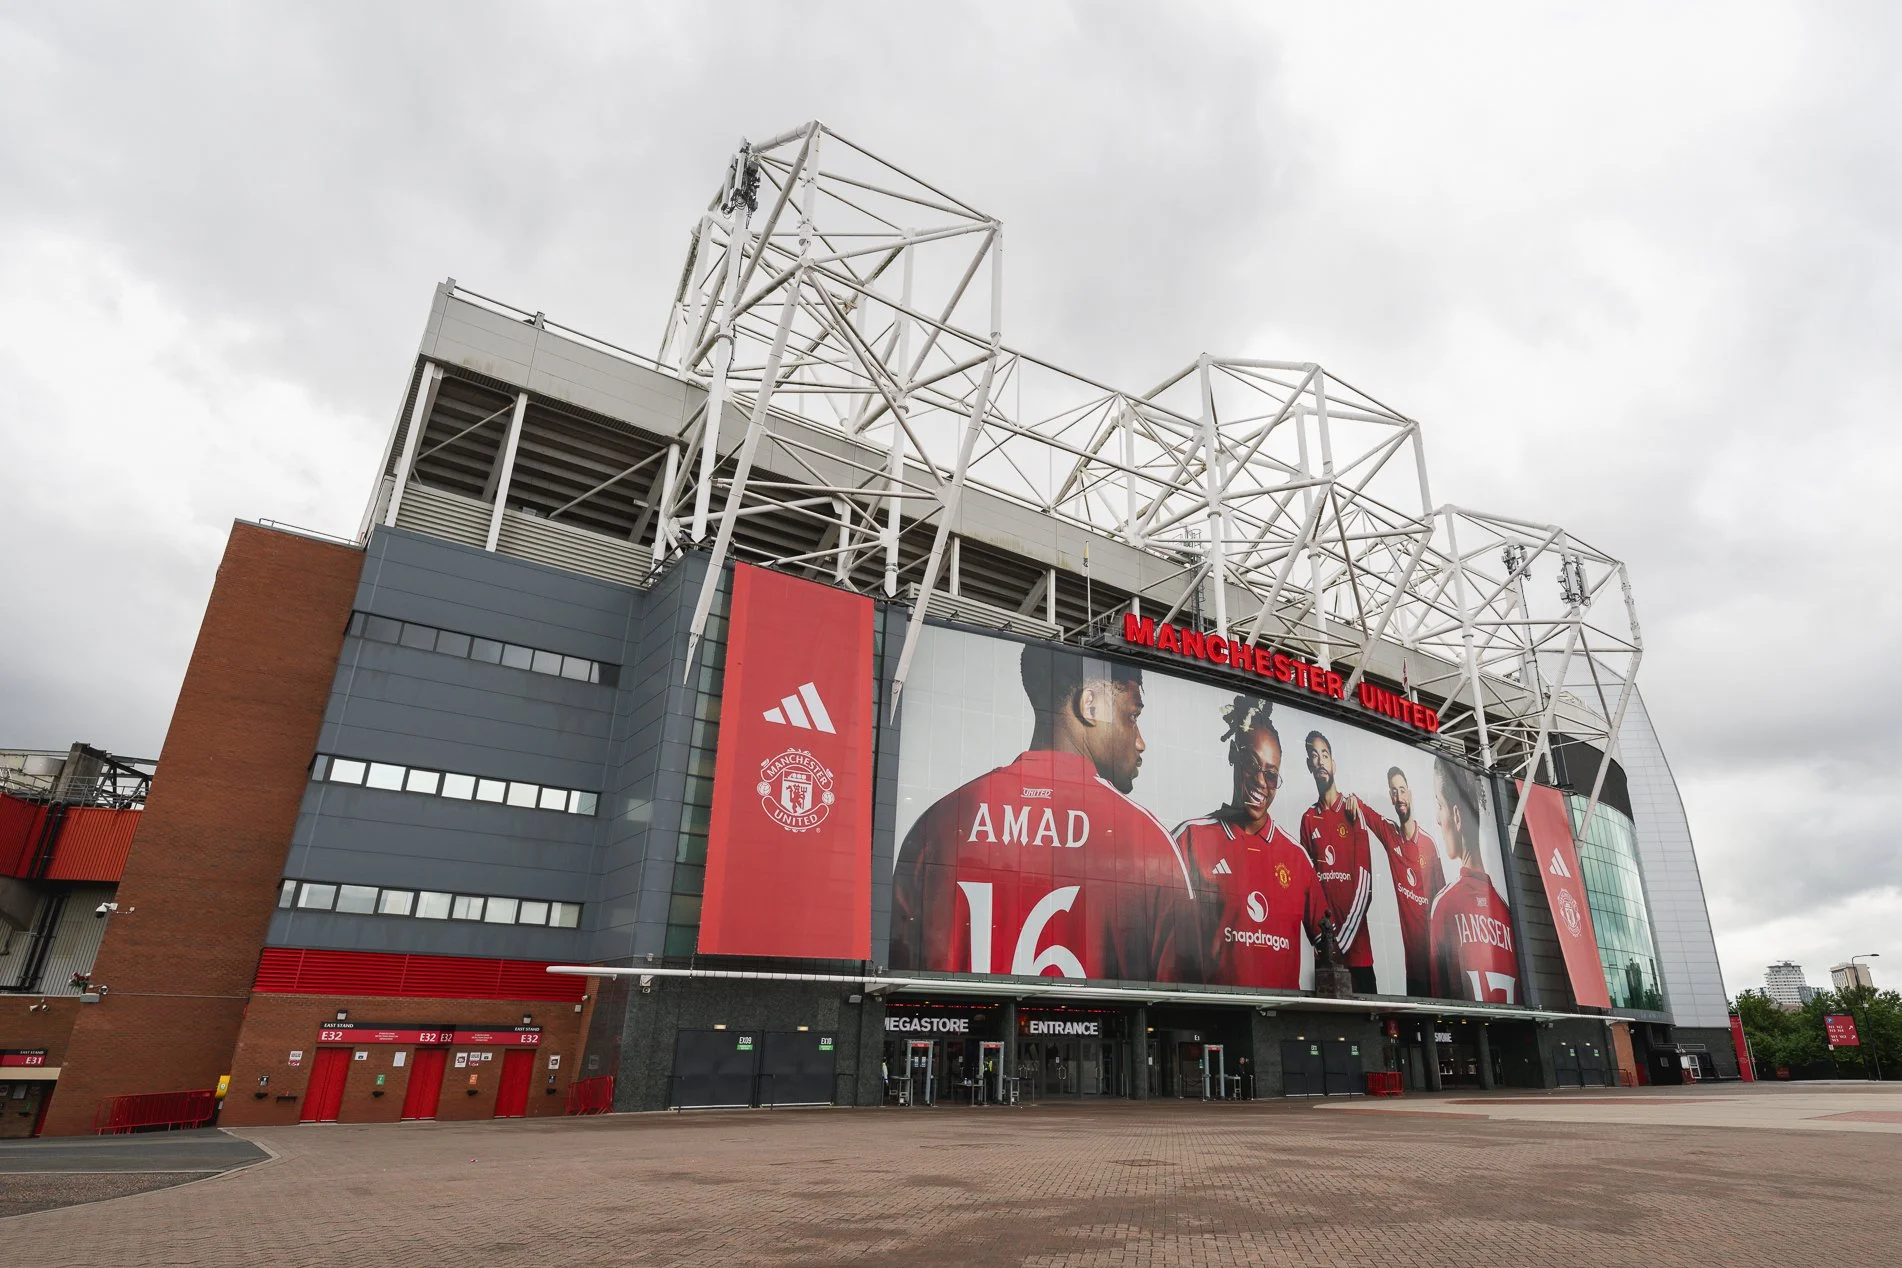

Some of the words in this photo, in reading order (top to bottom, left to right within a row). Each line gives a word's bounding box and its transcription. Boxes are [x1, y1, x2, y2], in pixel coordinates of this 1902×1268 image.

[1124, 612, 1344, 700] MANCHESTER
[1358, 680, 1439, 733] UNITED
[766, 754, 828, 786] MANCHESTER
[1022, 788, 1052, 797] UNITED
[774, 809, 818, 826] UNITED
[967, 802, 1090, 848] AMAD
[956, 881, 1087, 979] 16
[1454, 913, 1513, 952] JANSSEN
[1224, 926, 1290, 951] Snapdragon
[1029, 1020, 1099, 1035] ENTRANCE
[321, 1031, 343, 1041] E32
[419, 1032, 437, 1042] E32
[440, 1033, 453, 1042] E32
[520, 1034, 539, 1043] E32
[25, 1056, 42, 1065] E31
